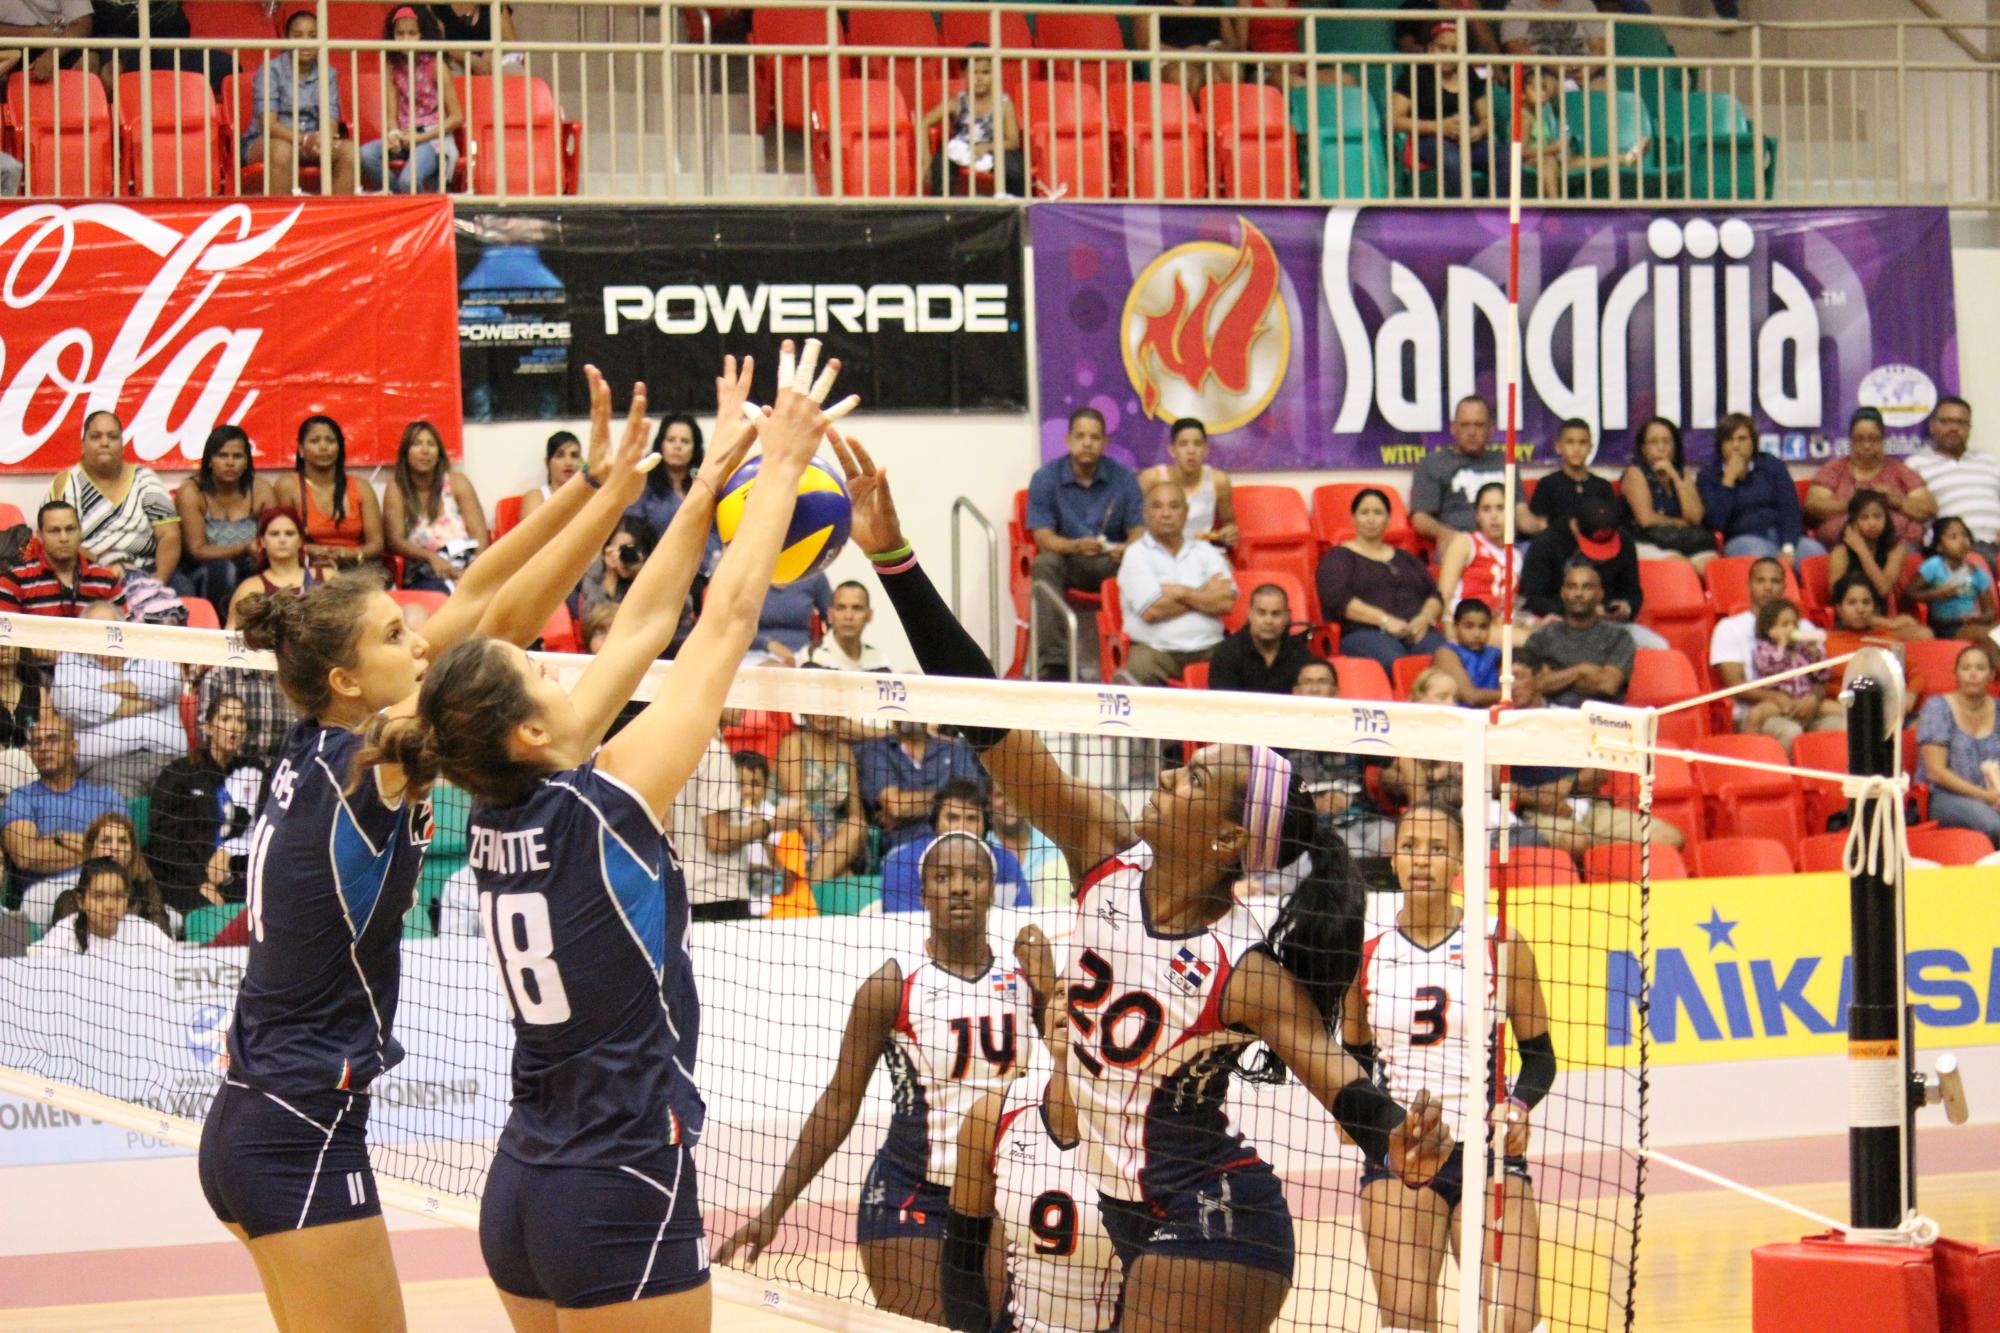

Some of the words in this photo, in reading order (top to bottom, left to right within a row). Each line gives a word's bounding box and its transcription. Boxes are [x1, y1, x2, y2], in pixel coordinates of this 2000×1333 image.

[480, 891, 572, 1026] 18
[1069, 947, 1165, 1068] 20
[1410, 987, 1451, 1045] 3
[1607, 945, 2000, 1047] MIKS
[950, 1013, 1016, 1079] 14
[347, 1171, 366, 1206] 11
[1029, 1190, 1078, 1257] 9
